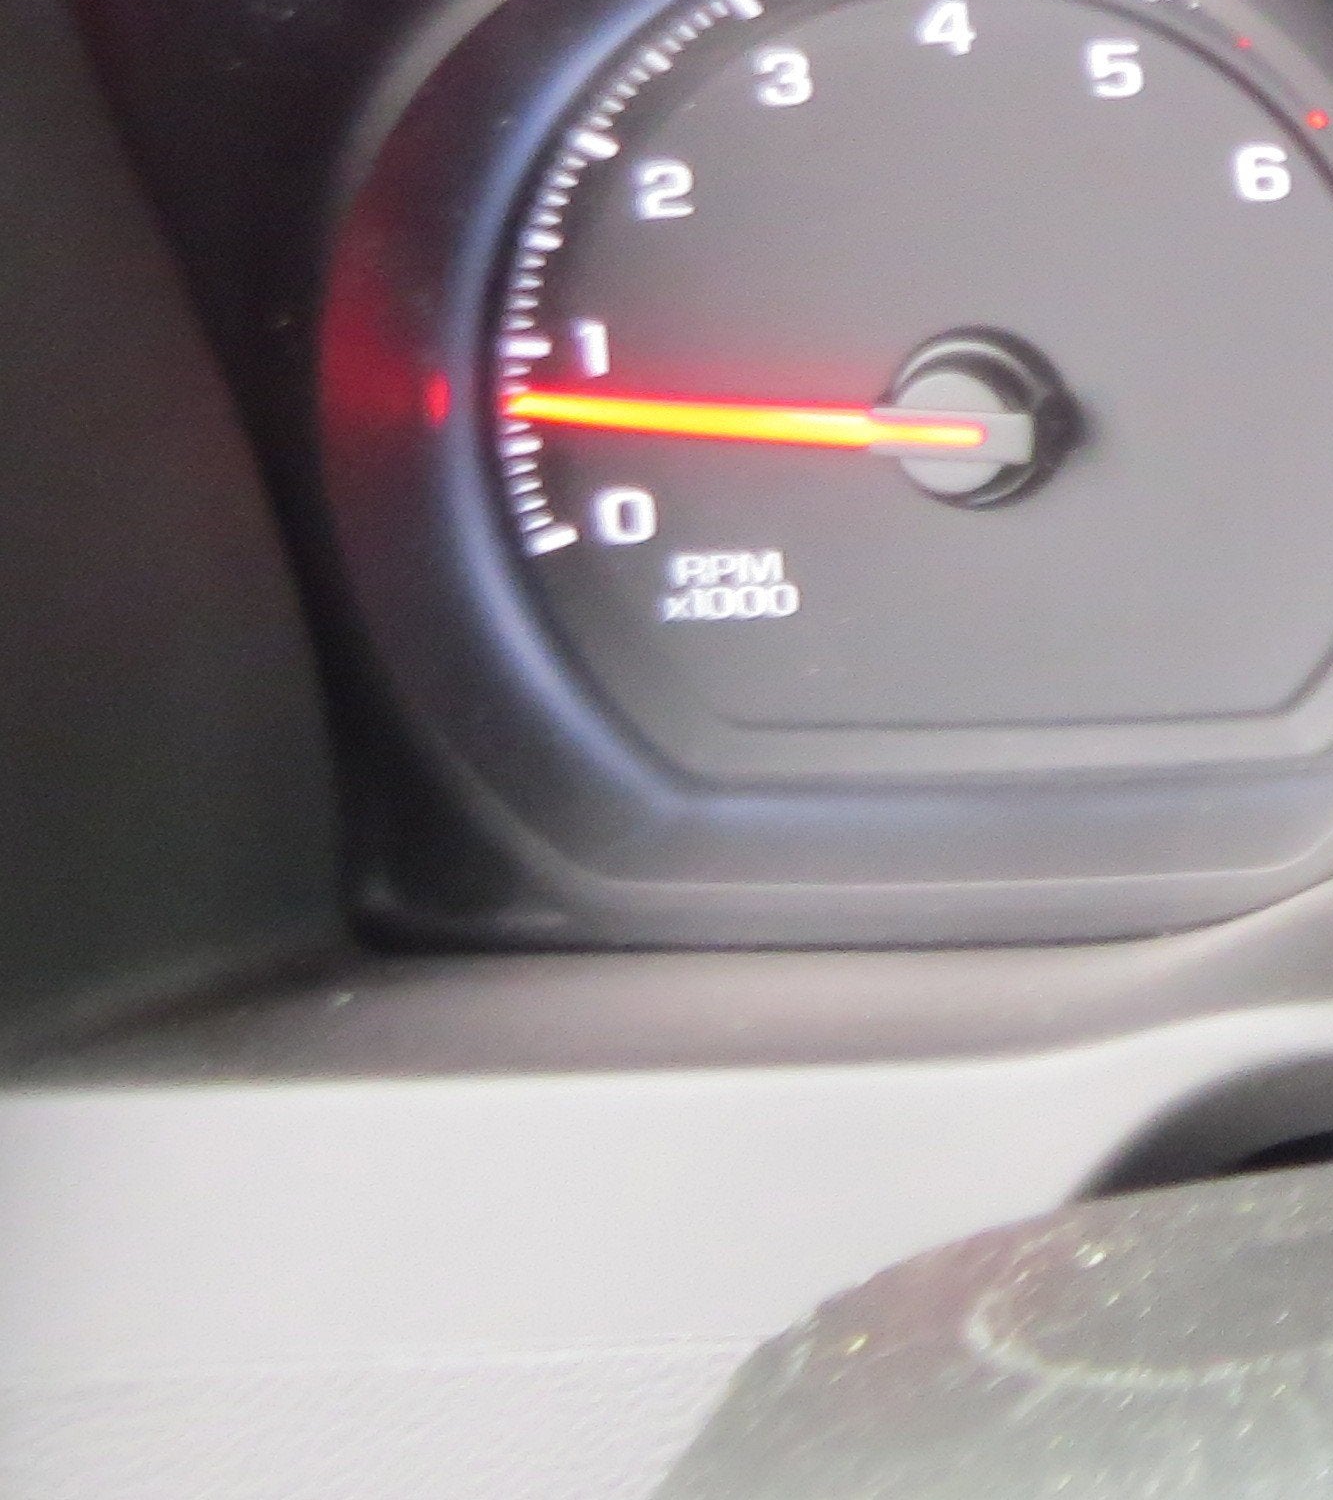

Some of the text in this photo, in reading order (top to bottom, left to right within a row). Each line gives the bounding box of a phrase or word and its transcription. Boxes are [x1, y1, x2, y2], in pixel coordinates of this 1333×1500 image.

[919, 0, 976, 54] 4
[754, 48, 812, 106] 3
[1086, 38, 1142, 97] 5
[634, 160, 694, 220] 2
[1234, 144, 1291, 202] 6
[573, 320, 609, 377] 1
[595, 488, 656, 544] 0
[673, 551, 784, 586] RPM
